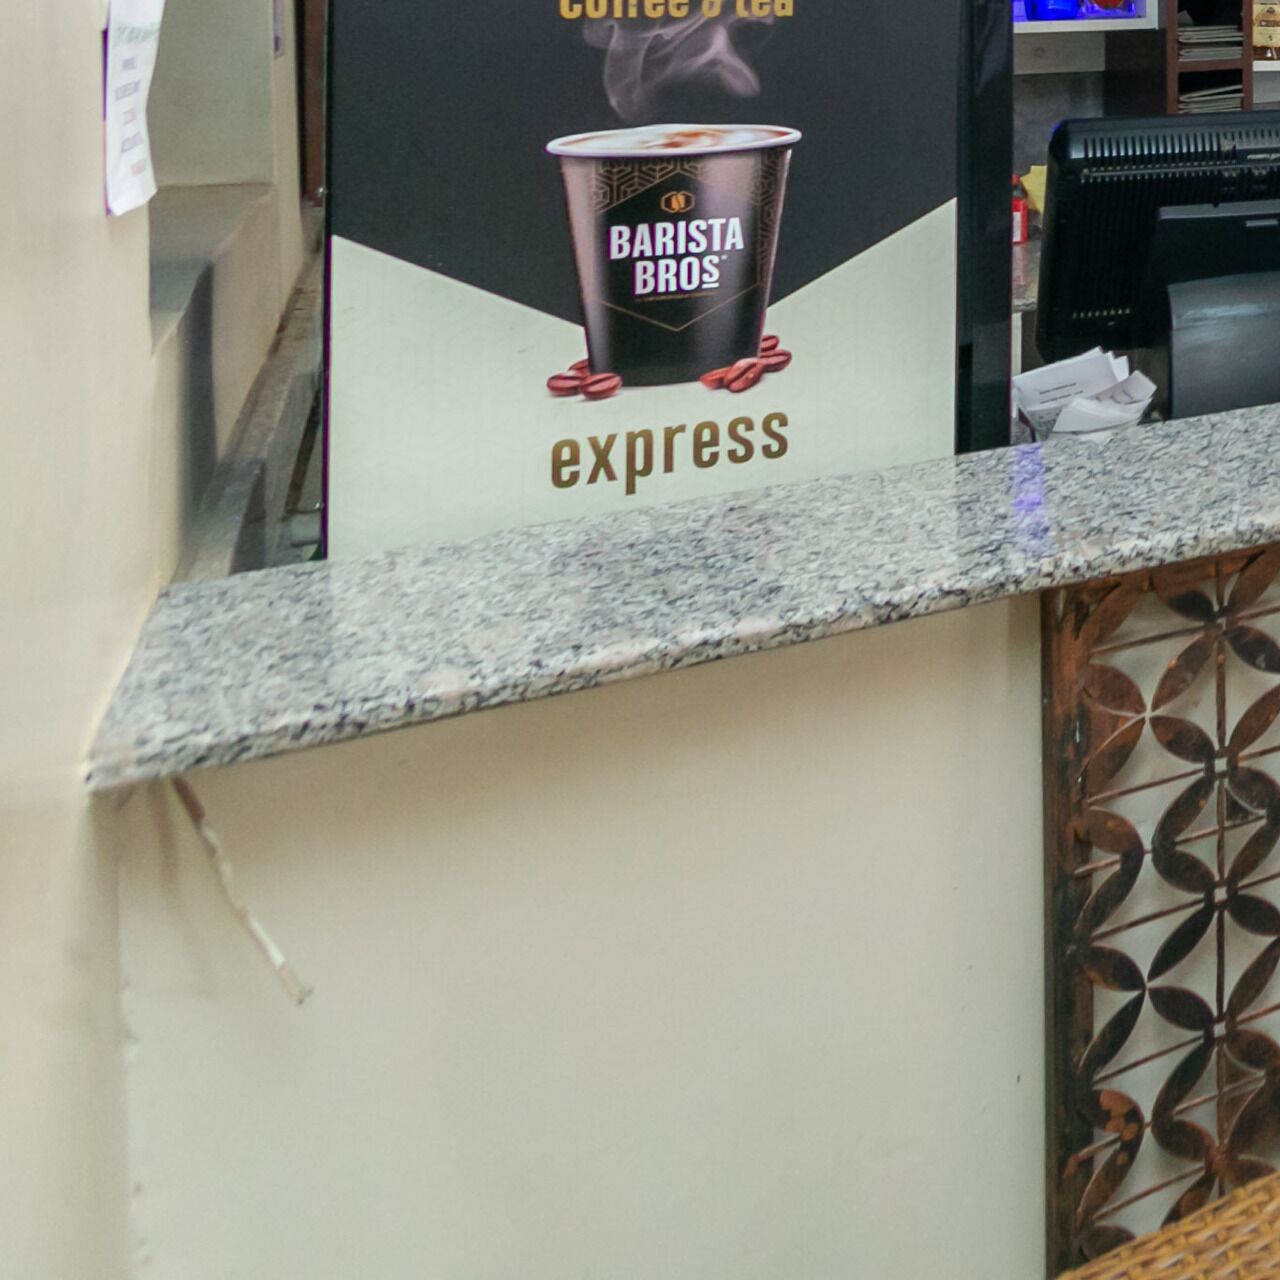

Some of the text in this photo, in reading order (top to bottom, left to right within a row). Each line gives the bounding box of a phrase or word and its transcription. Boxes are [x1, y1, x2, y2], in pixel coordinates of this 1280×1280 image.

[609, 216, 745, 260] BARISTA
[633, 253, 720, 295] BROS
[550, 411, 789, 497] express
